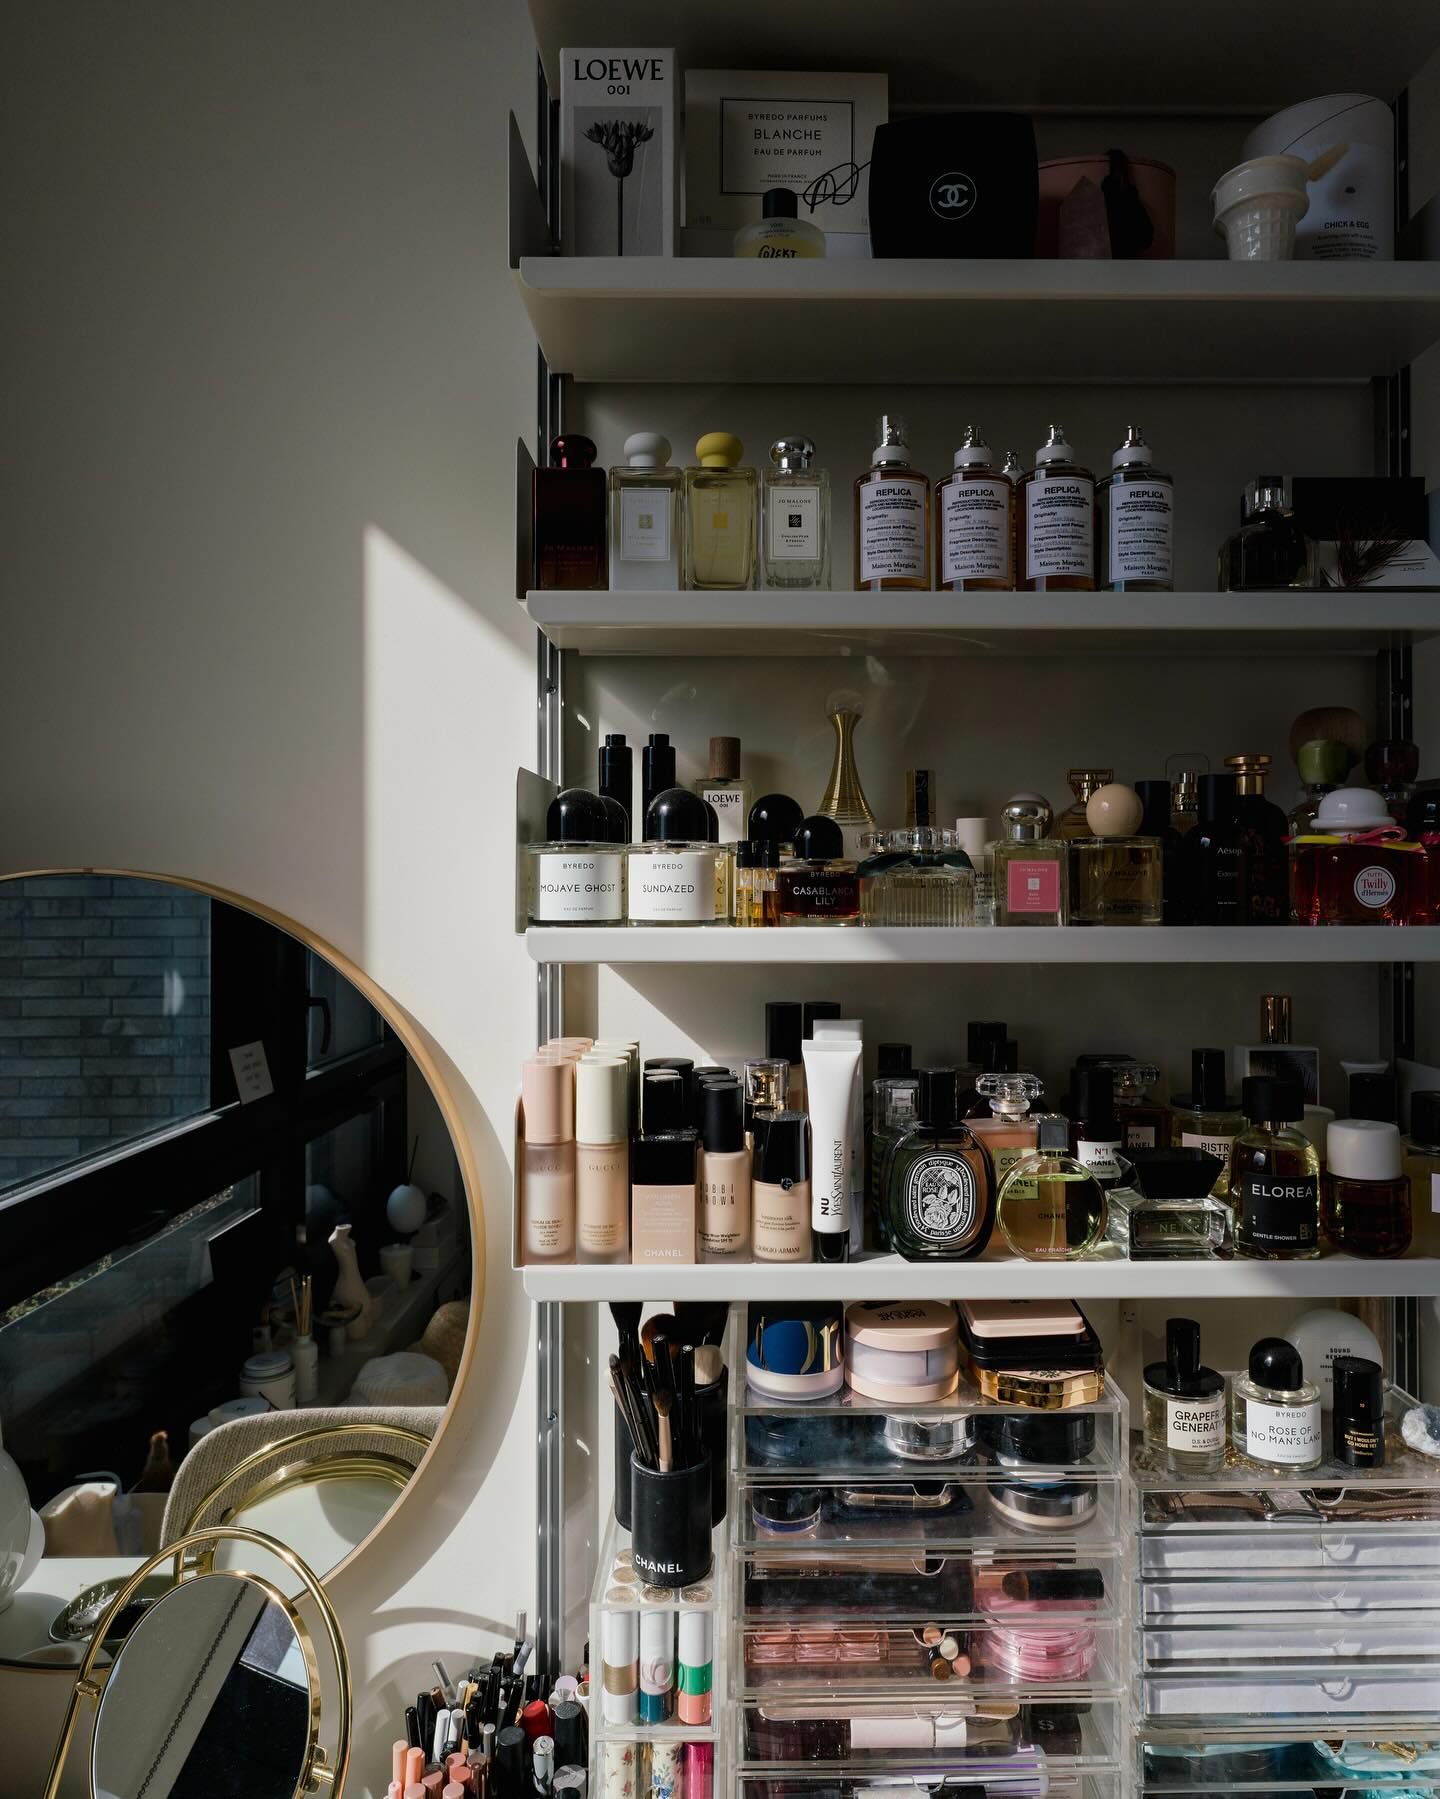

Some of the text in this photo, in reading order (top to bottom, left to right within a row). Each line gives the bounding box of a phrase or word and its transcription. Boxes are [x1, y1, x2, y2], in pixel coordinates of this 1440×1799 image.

[574, 59, 664, 81] LOEWE
[607, 85, 631, 95] 001
[787, 114, 827, 122] PARFUMS
[754, 129, 822, 141] BLANCHE
[773, 148, 784, 156] DE
[1324, 221, 1348, 229] CHICK
[1356, 221, 1369, 229] EGG
[876, 488, 912, 496] REPLICA
[959, 489, 994, 497] REPLICA
[1130, 491, 1164, 499] REPLICA
[708, 794, 740, 803] LOEWE
[540, 884, 615, 893] MOJAVE GHOST
[642, 884, 695, 893] SUNDAZED
[1360, 878, 1388, 890] Twilly
[792, 886, 855, 896] CASABLANCA
[815, 896, 836, 906] LILY
[1200, 1143, 1230, 1153] BISTR
[589, 1163, 621, 1171] GUCCI
[1012, 1179, 1035, 1187] ANEL
[1252, 1183, 1313, 1198] ELOREA
[821, 1198, 830, 1215] NU
[1252, 1232, 1273, 1240] GENTLE
[644, 1249, 683, 1257] CHANEL
[1269, 1425, 1312, 1436] ROSE OF
[1251, 1431, 1266, 1441] NO
[1269, 1435, 1301, 1445] MAN'S
[635, 1554, 684, 1573] CHANEL
